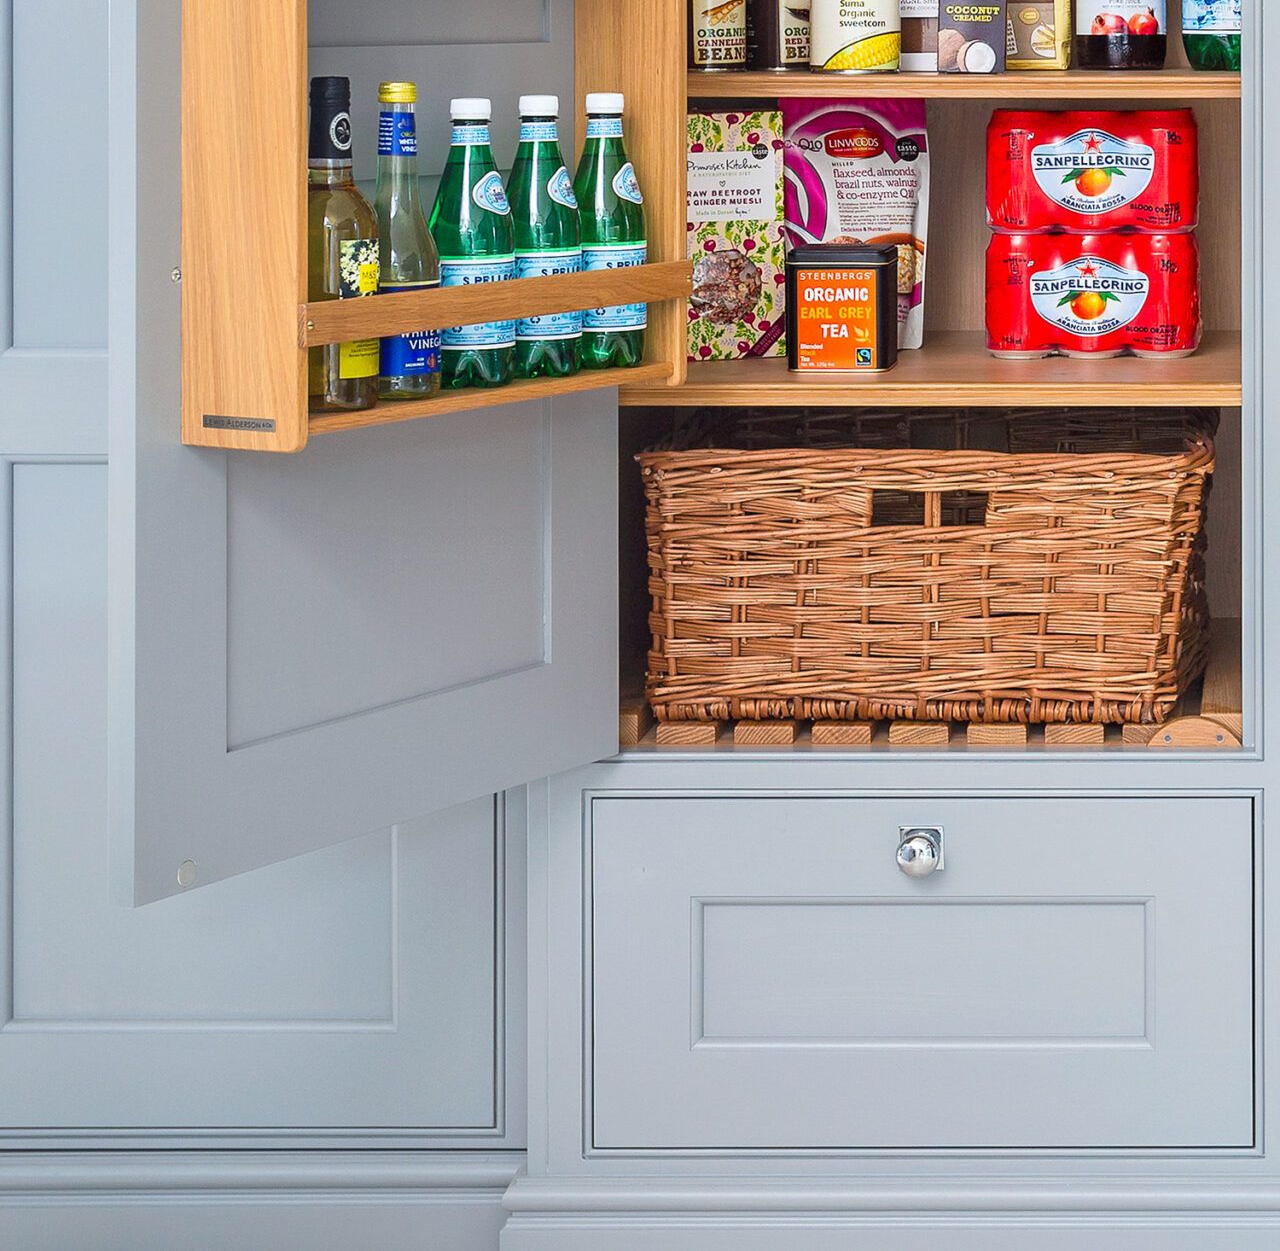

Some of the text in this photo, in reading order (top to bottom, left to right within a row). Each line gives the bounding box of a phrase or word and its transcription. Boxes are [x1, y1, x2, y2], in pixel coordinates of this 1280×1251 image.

[839, 0, 865, 9] Suma
[946, 5, 1000, 15] COCONUT
[839, 8, 876, 20] Organic
[953, 14, 993, 23] CREAMED
[839, 18, 887, 29] sweetcorn
[828, 137, 879, 148] LINWOODS
[896, 144, 918, 152] taste
[726, 157, 763, 171] Kitchen
[1035, 154, 1151, 168] SANPELLEGRINO
[833, 166, 917, 178] flaxseed, almonds,
[835, 178, 918, 189] brazil nuts, walnuts
[711, 189, 762, 197] BEETROOT
[836, 190, 899, 201] & co-enzyme
[693, 197, 762, 206] GINGER MUESLI
[1060, 194, 1127, 212] ARANCIATA ROSSA
[800, 272, 872, 281] STEENBERGS
[1033, 278, 1145, 292] SANPELLEGRINO
[804, 287, 869, 302] ORGANIC
[800, 306, 872, 319] EARL GREY
[820, 323, 849, 338] TEA
[1055, 317, 1121, 333] ARANCIATA ROSSA
[204, 417, 262, 429] LEWIS ALDERSON
